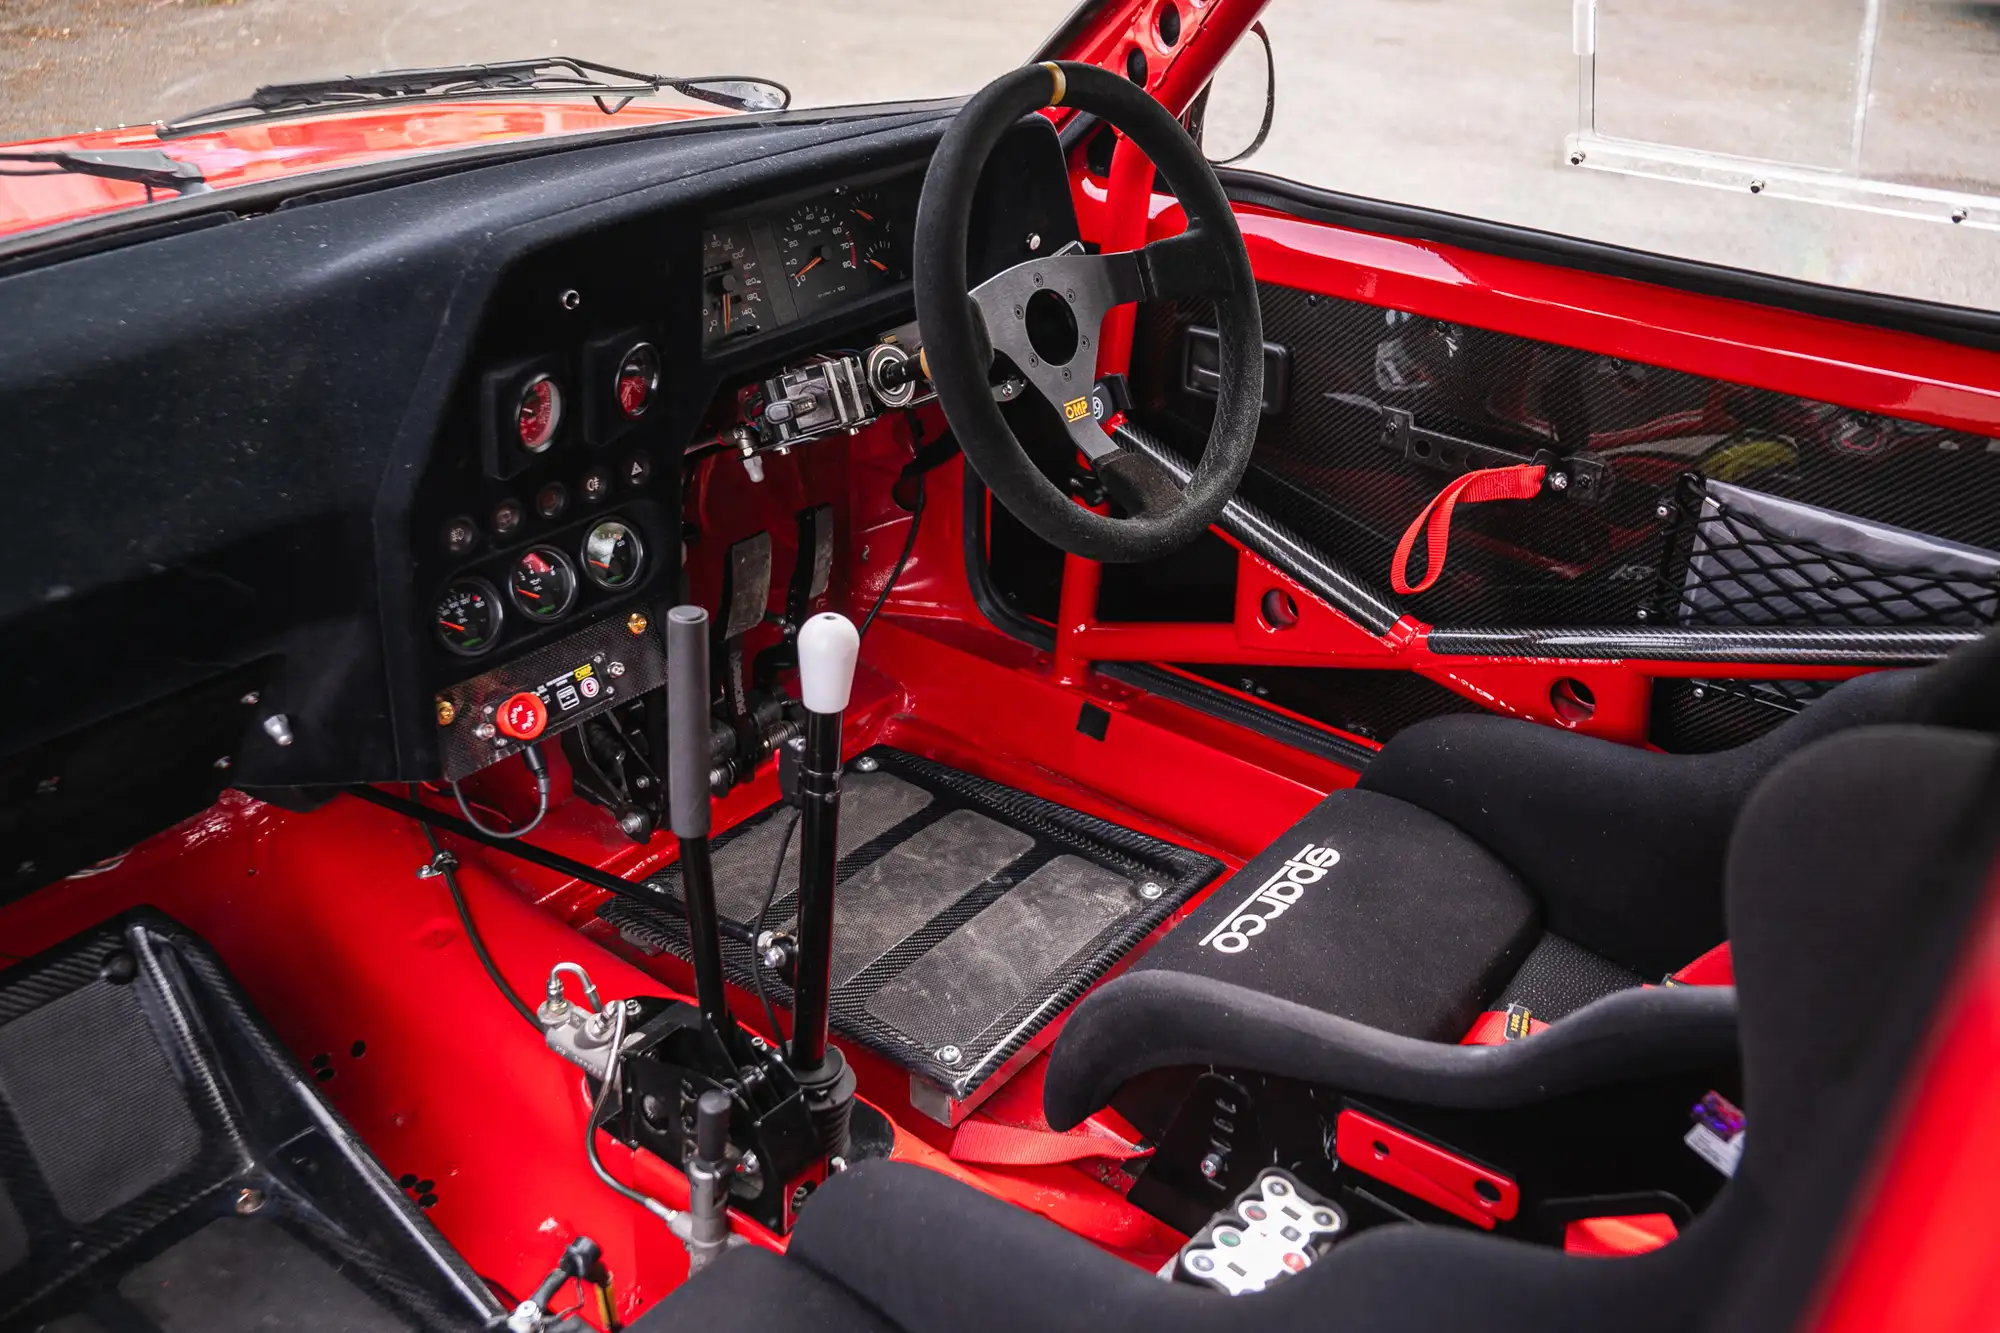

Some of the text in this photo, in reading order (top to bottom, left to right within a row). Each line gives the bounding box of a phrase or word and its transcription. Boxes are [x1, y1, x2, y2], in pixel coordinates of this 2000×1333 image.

[805, 213, 815, 221] 40
[819, 215, 830, 224] 50
[792, 223, 803, 232] 30
[832, 226, 842, 235] 60
[788, 239, 799, 248] 20
[840, 241, 850, 250] 70
[790, 258, 798, 266] 10
[842, 260, 852, 269] 80
[745, 277, 756, 286] 120
[741, 307, 753, 317] 140
[1065, 400, 1089, 419] OMP
[586, 682, 594, 693] E
[510, 704, 523, 725] PUSH
[521, 709, 535, 730] PUSH
[1209, 845, 1341, 954] sparco
[1510, 1013, 1521, 1032] 2021
